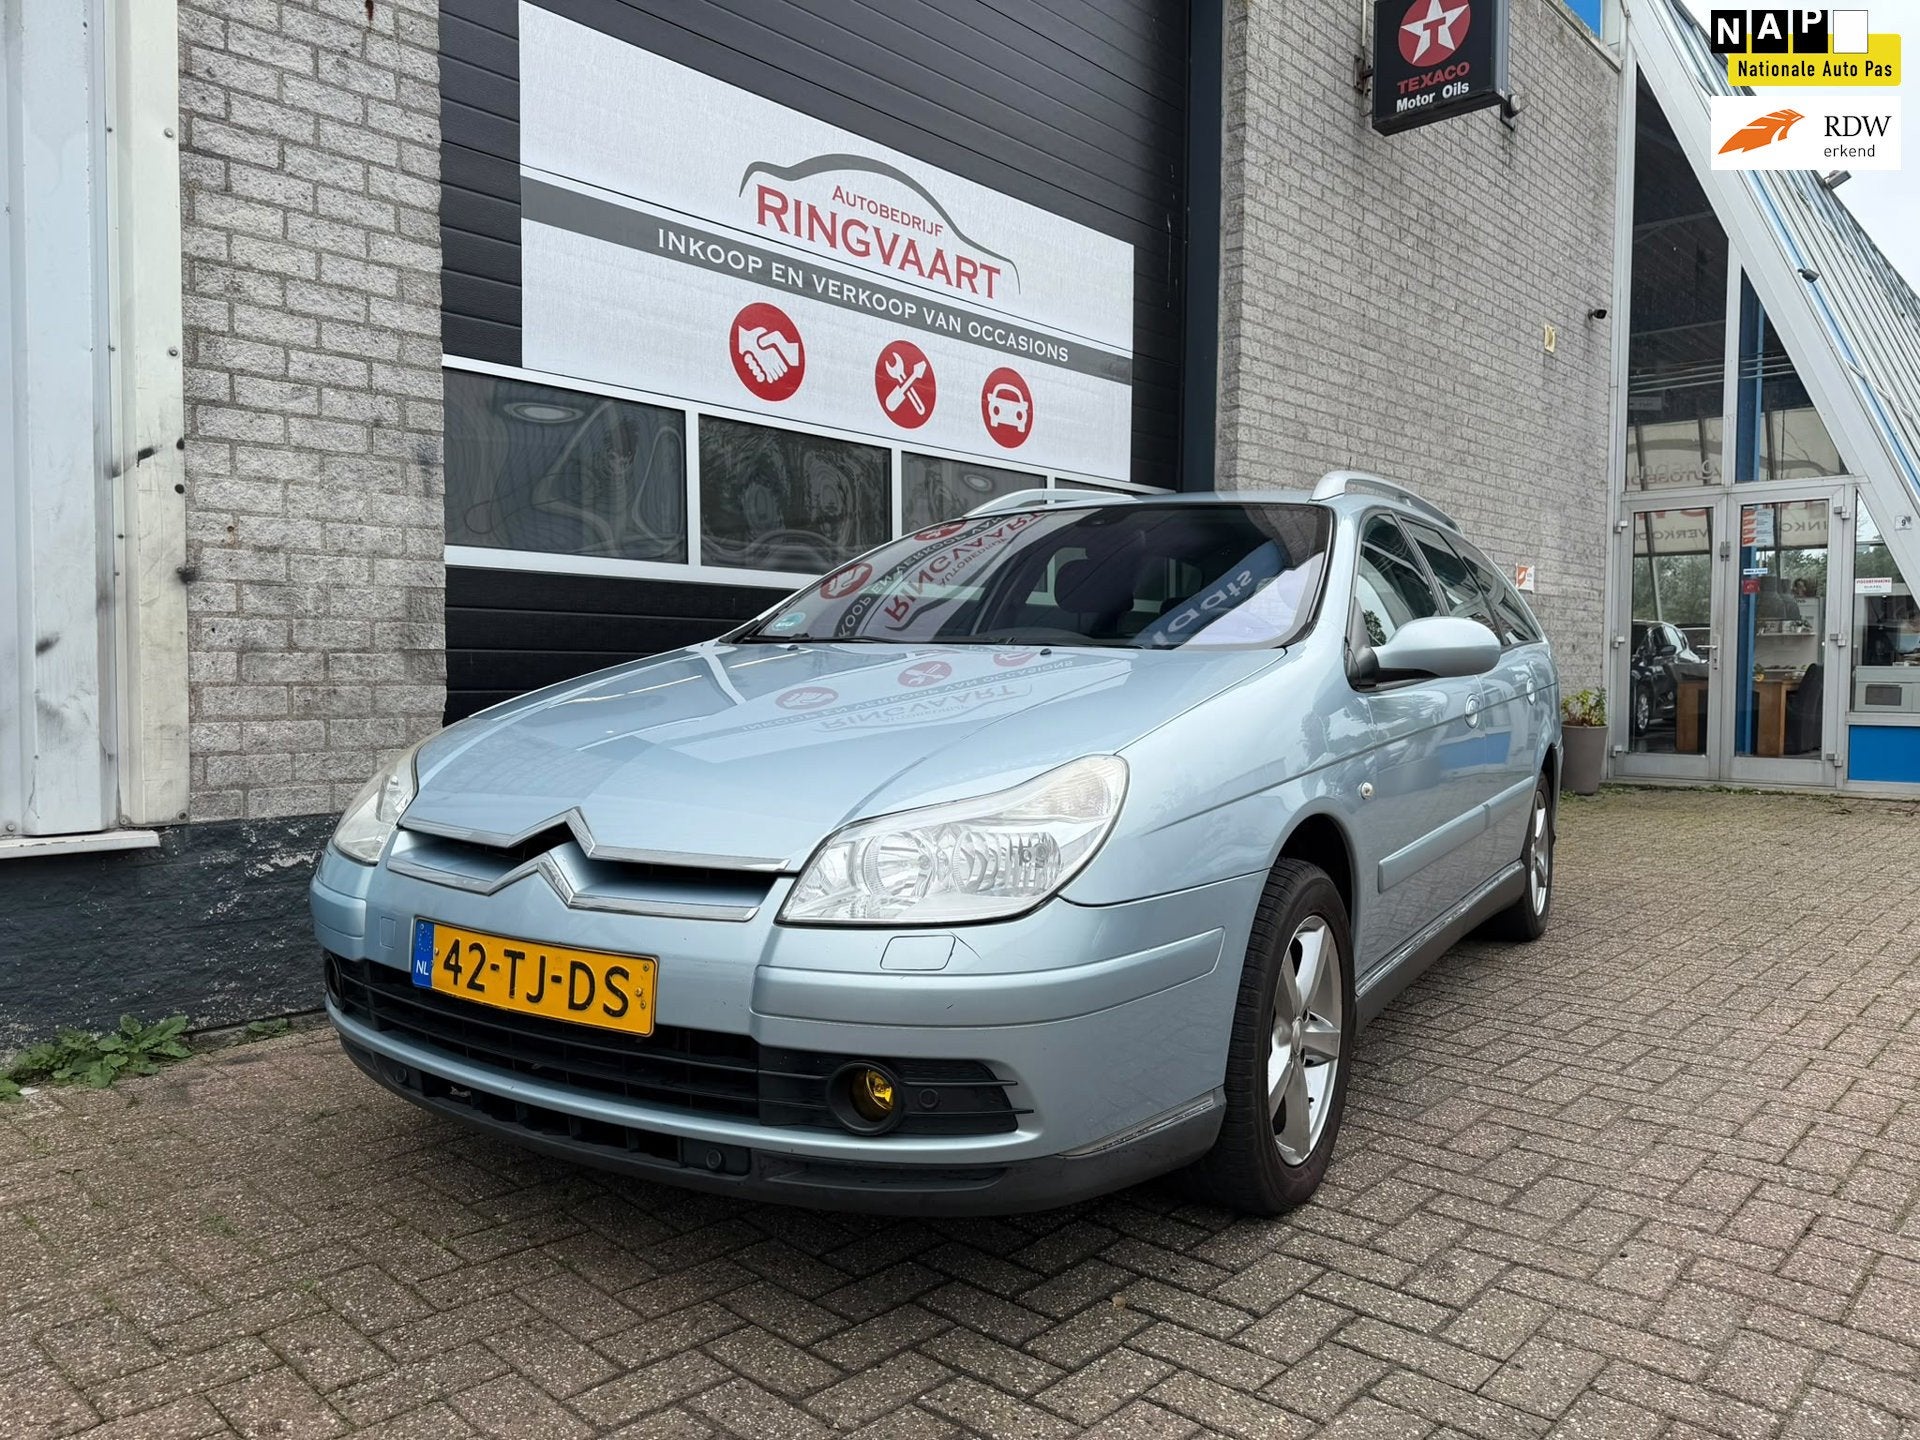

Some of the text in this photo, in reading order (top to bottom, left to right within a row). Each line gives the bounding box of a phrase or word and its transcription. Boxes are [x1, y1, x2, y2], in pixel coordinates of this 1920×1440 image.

[1396, 81, 1469, 113] Motor Oils
[1397, 62, 1470, 95] TEXACO
[756, 184, 1001, 299] RINGVAART
[832, 184, 944, 238] AUTOBEDRIJF
[658, 228, 1069, 363] INKOOP EN VERKOOP VAN OCCASIONS
[415, 938, 630, 1018] NL 42-TJ-DS
